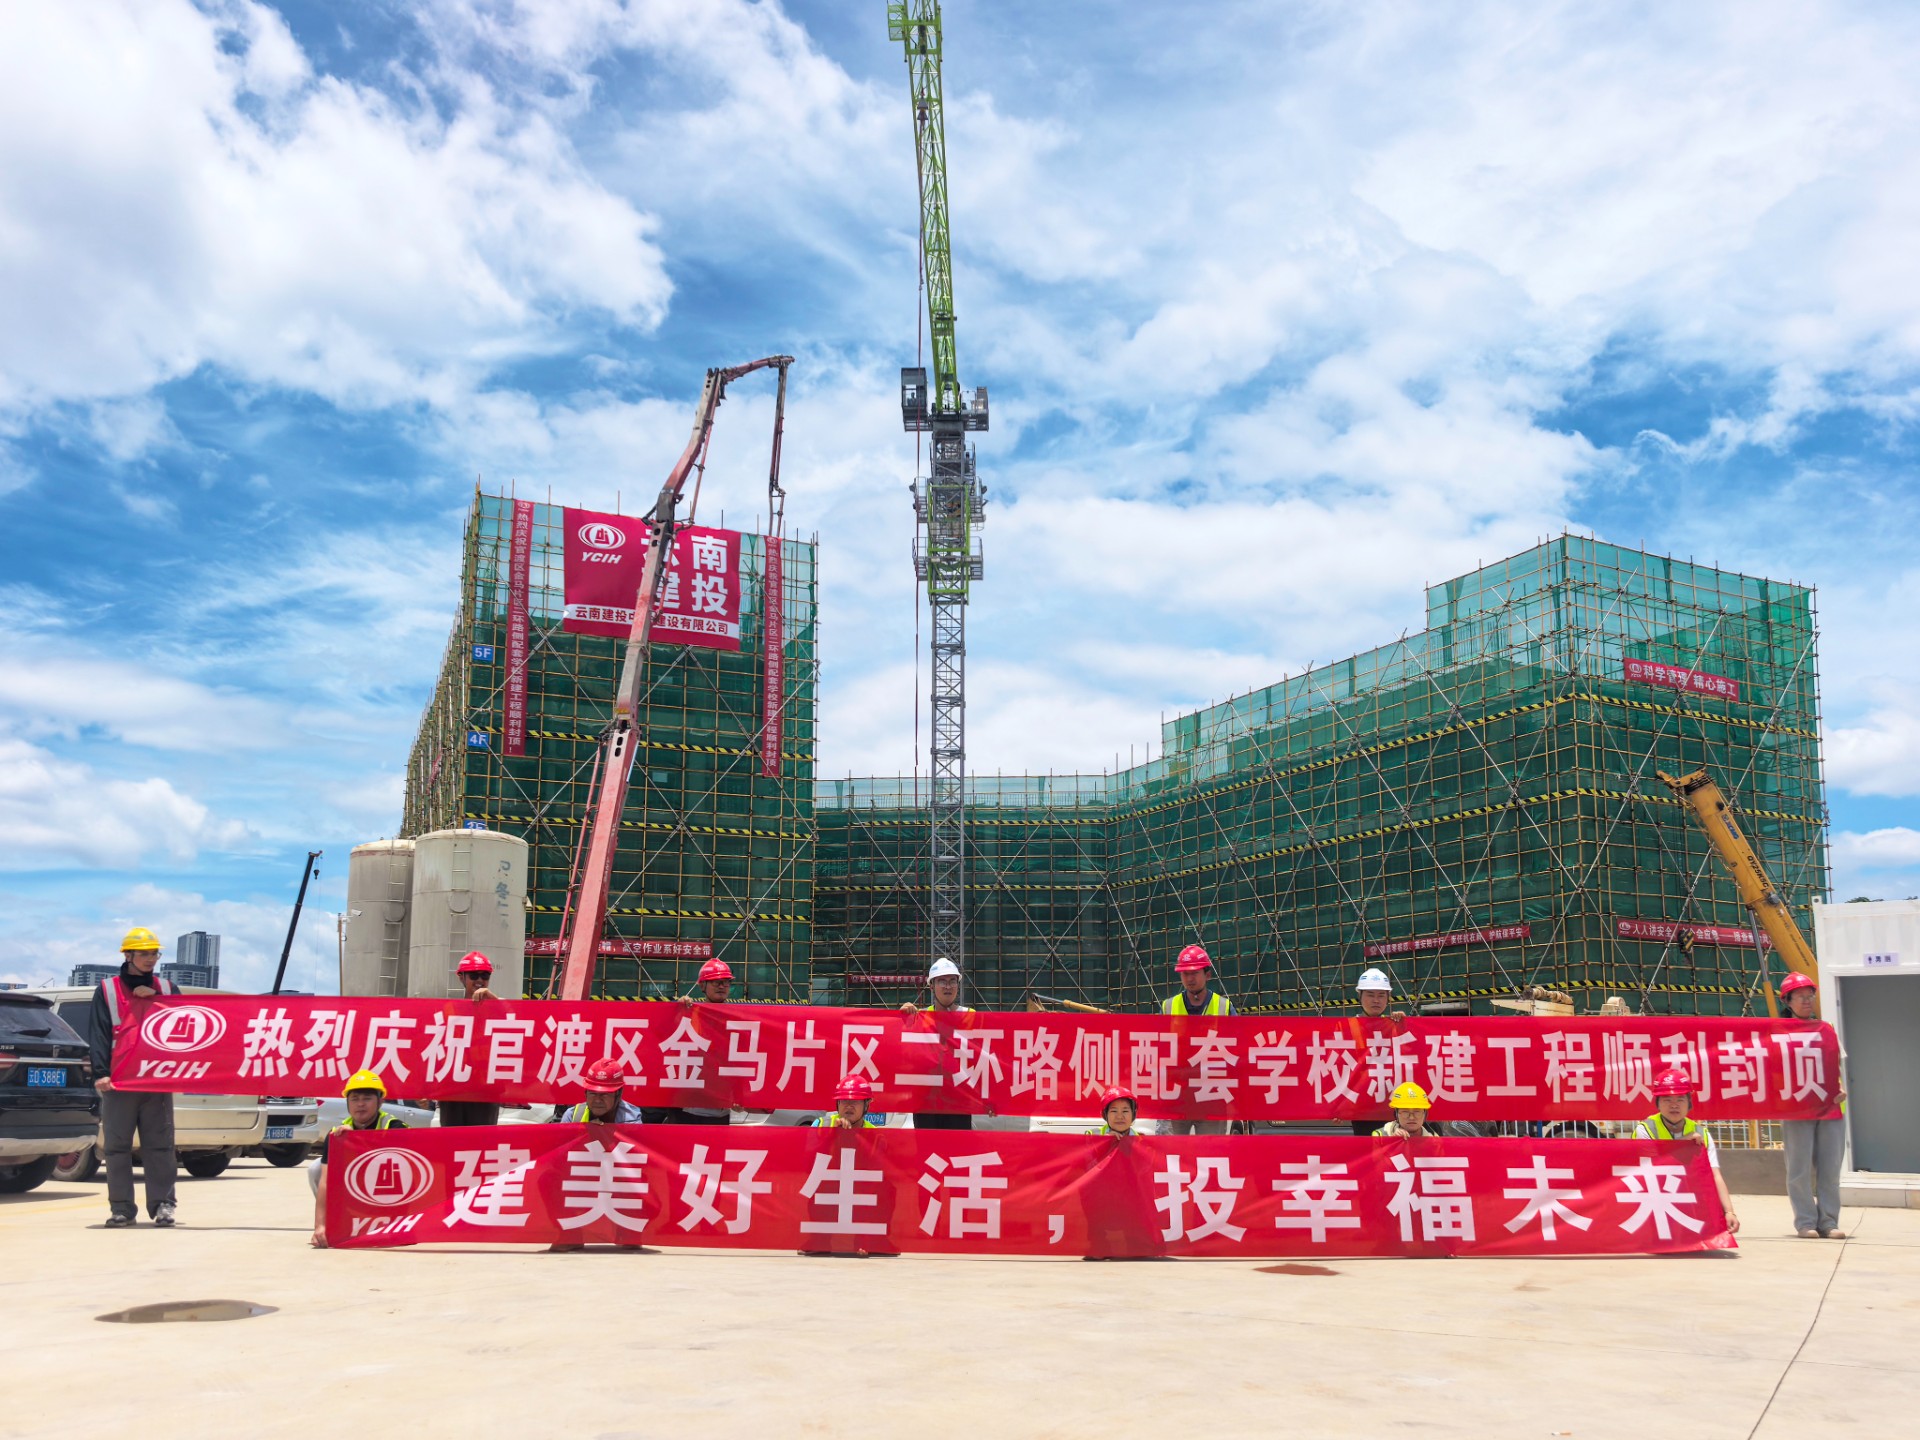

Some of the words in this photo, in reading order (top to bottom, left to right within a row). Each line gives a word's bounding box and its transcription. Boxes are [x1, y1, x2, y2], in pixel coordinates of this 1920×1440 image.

[580, 551, 622, 565] YCIH
[575, 606, 729, 635] 云南建投中建设有限公司
[475, 647, 491, 658] 5F
[1643, 664, 1687, 686] 科学管理
[1693, 674, 1736, 697] 精心施工
[470, 734, 487, 745] 4F
[237, 1008, 1829, 1105] 热烈庆祝官渡区金马片区二环路侧配套学校新建工程顺利封顶
[136, 1059, 212, 1079] YCIH
[444, 1140, 1706, 1244] 建美好生活，投幸福未来
[349, 1213, 421, 1237] YCIH
